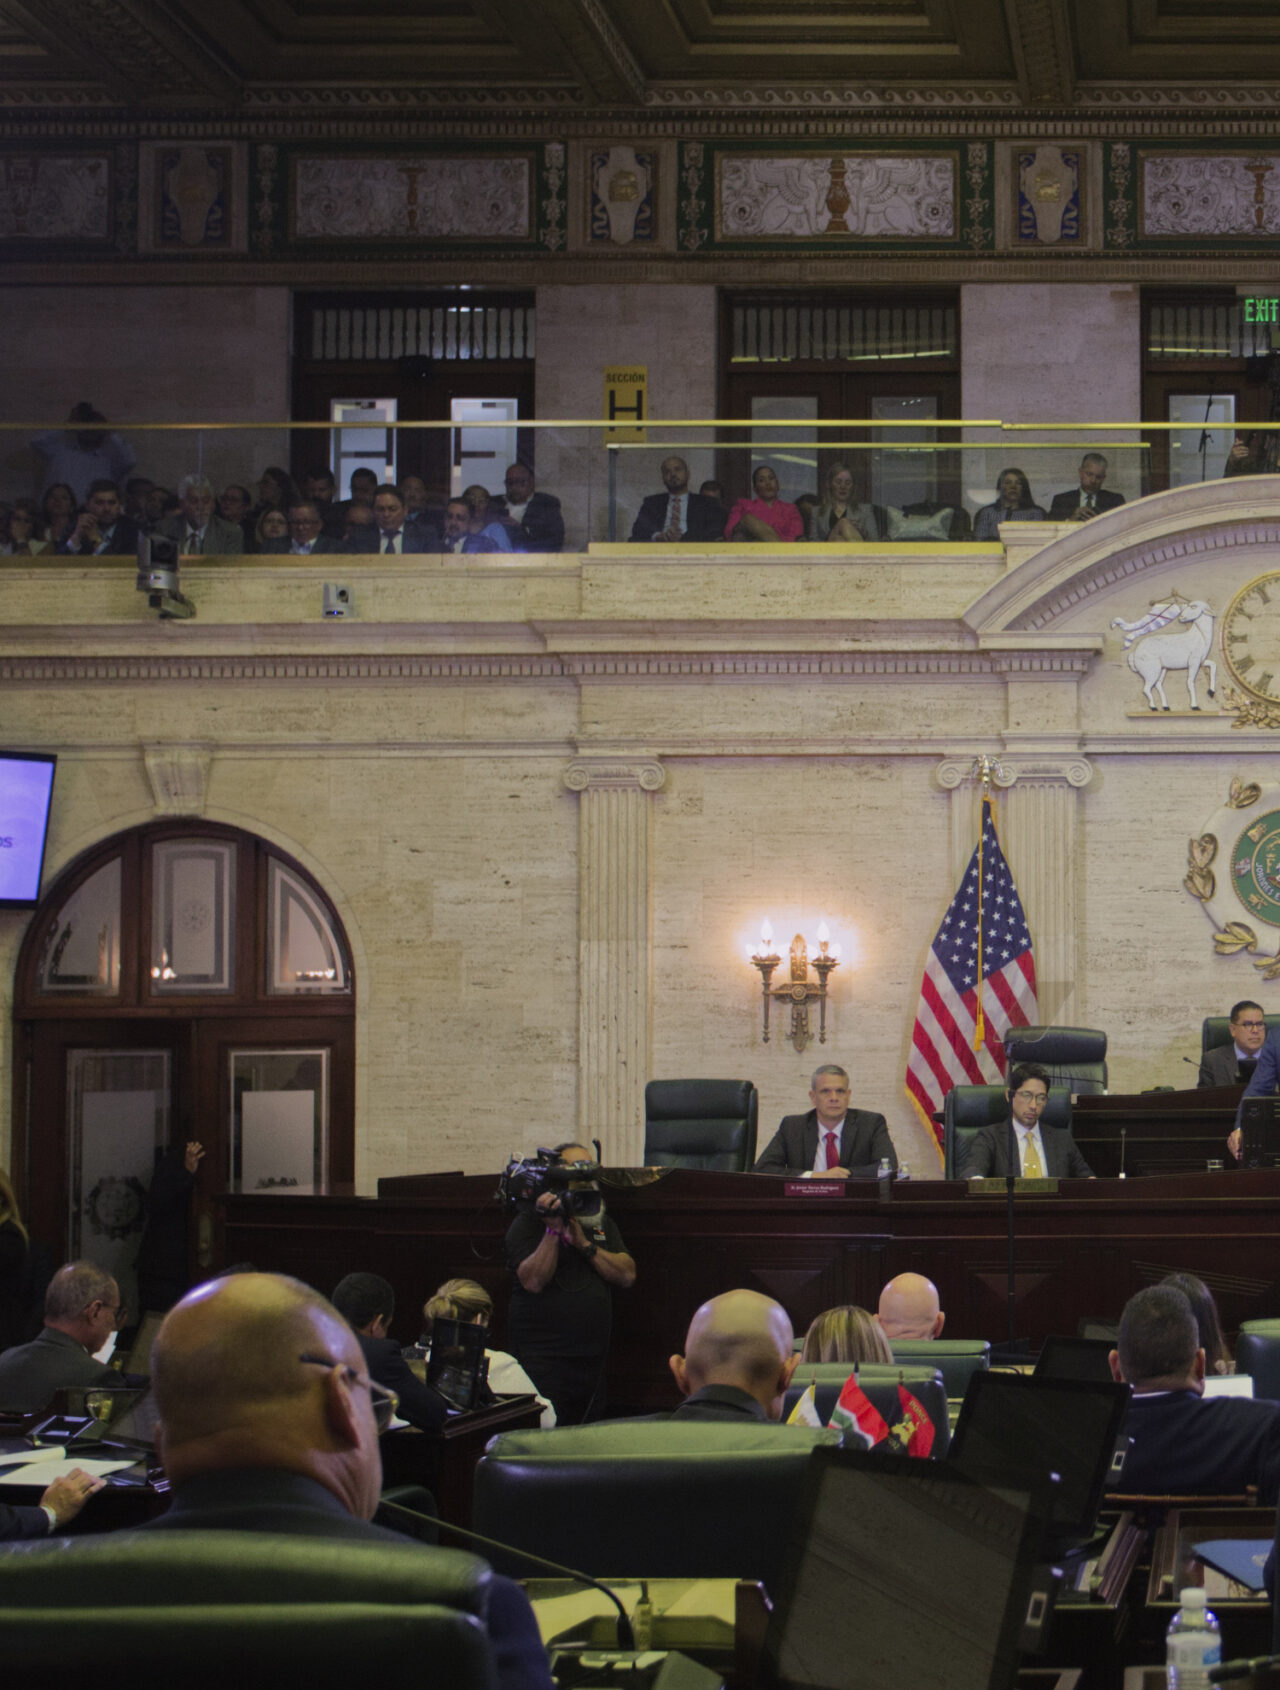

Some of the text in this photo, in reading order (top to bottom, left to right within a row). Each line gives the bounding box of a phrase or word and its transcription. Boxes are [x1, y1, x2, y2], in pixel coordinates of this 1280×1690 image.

[1245, 299, 1279, 322] EXIT
[606, 372, 645, 383] SECCIÓN
[609, 390, 643, 431] H
